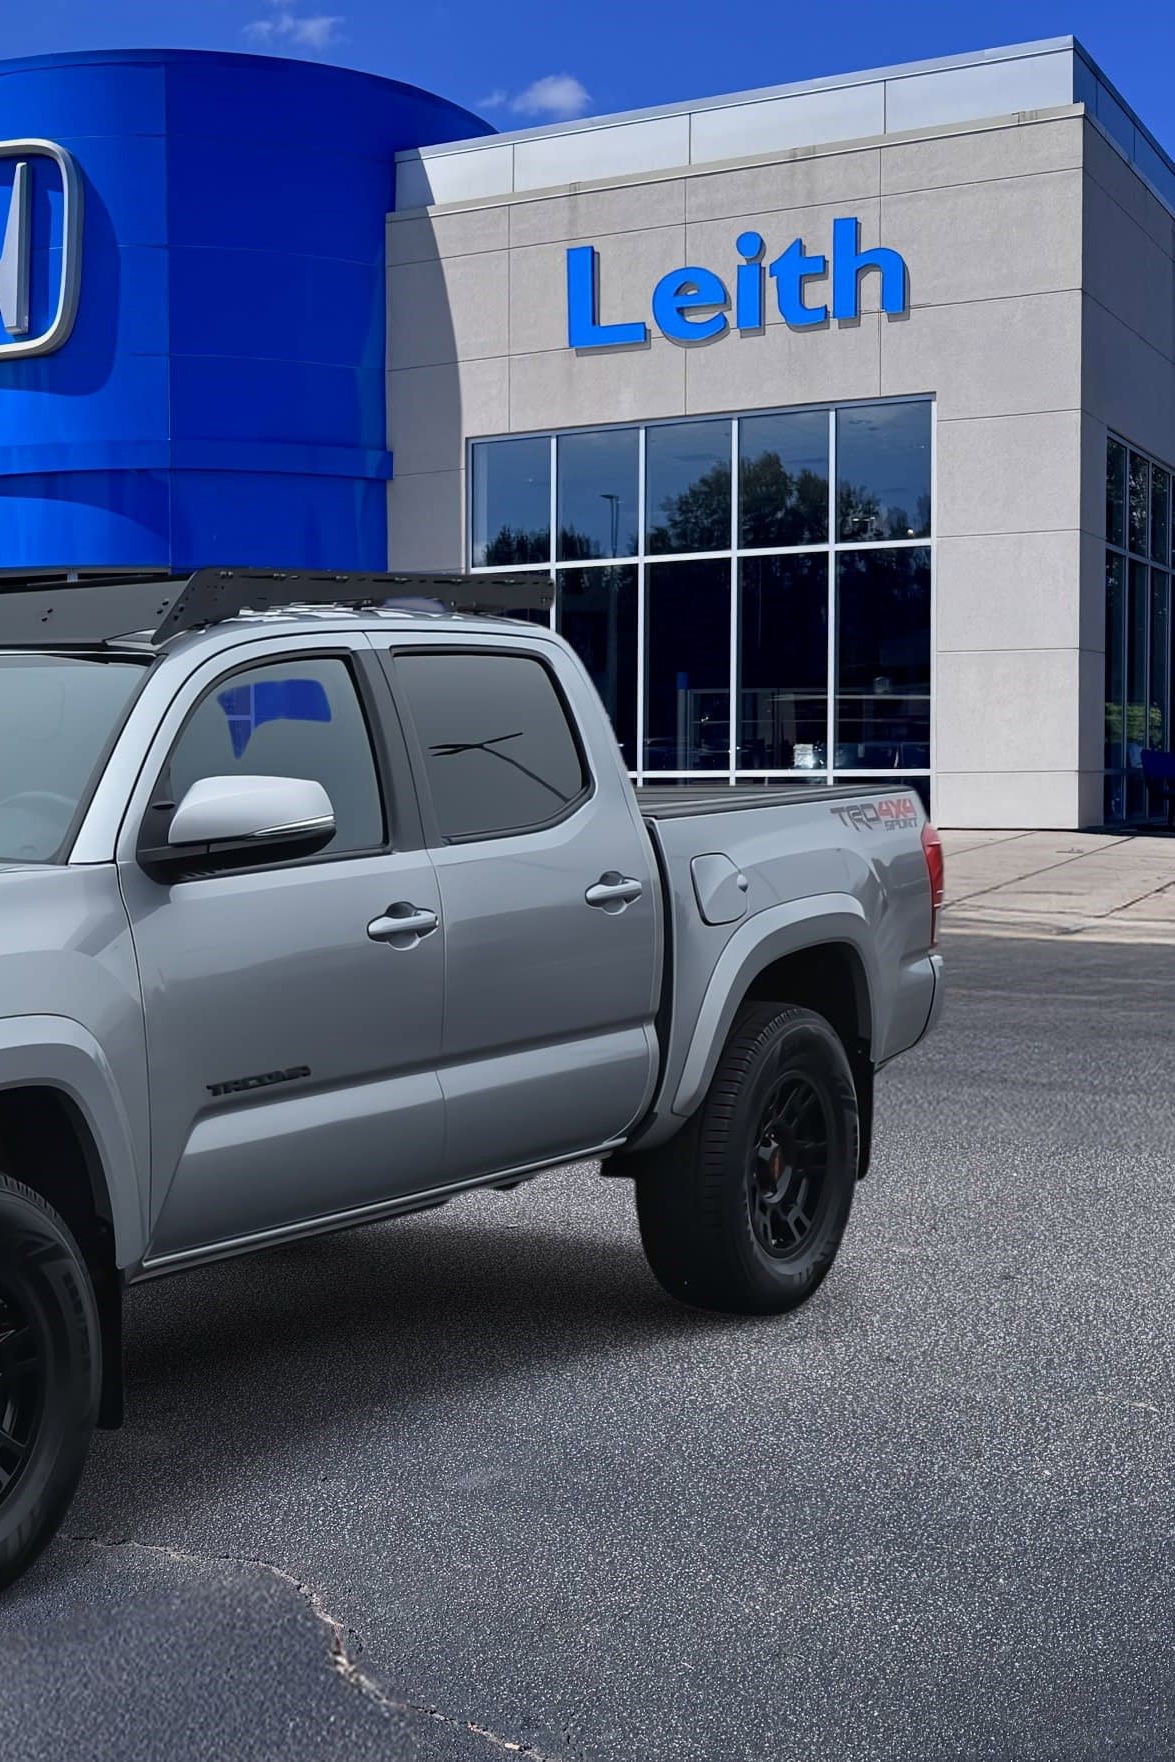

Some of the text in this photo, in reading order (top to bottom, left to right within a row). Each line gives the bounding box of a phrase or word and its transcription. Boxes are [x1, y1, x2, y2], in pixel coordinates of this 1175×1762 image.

[566, 217, 907, 349] Leith
[830, 803, 882, 832] TRD
[884, 817, 918, 831] SPORT
[206, 1065, 311, 1096] TACOMA
